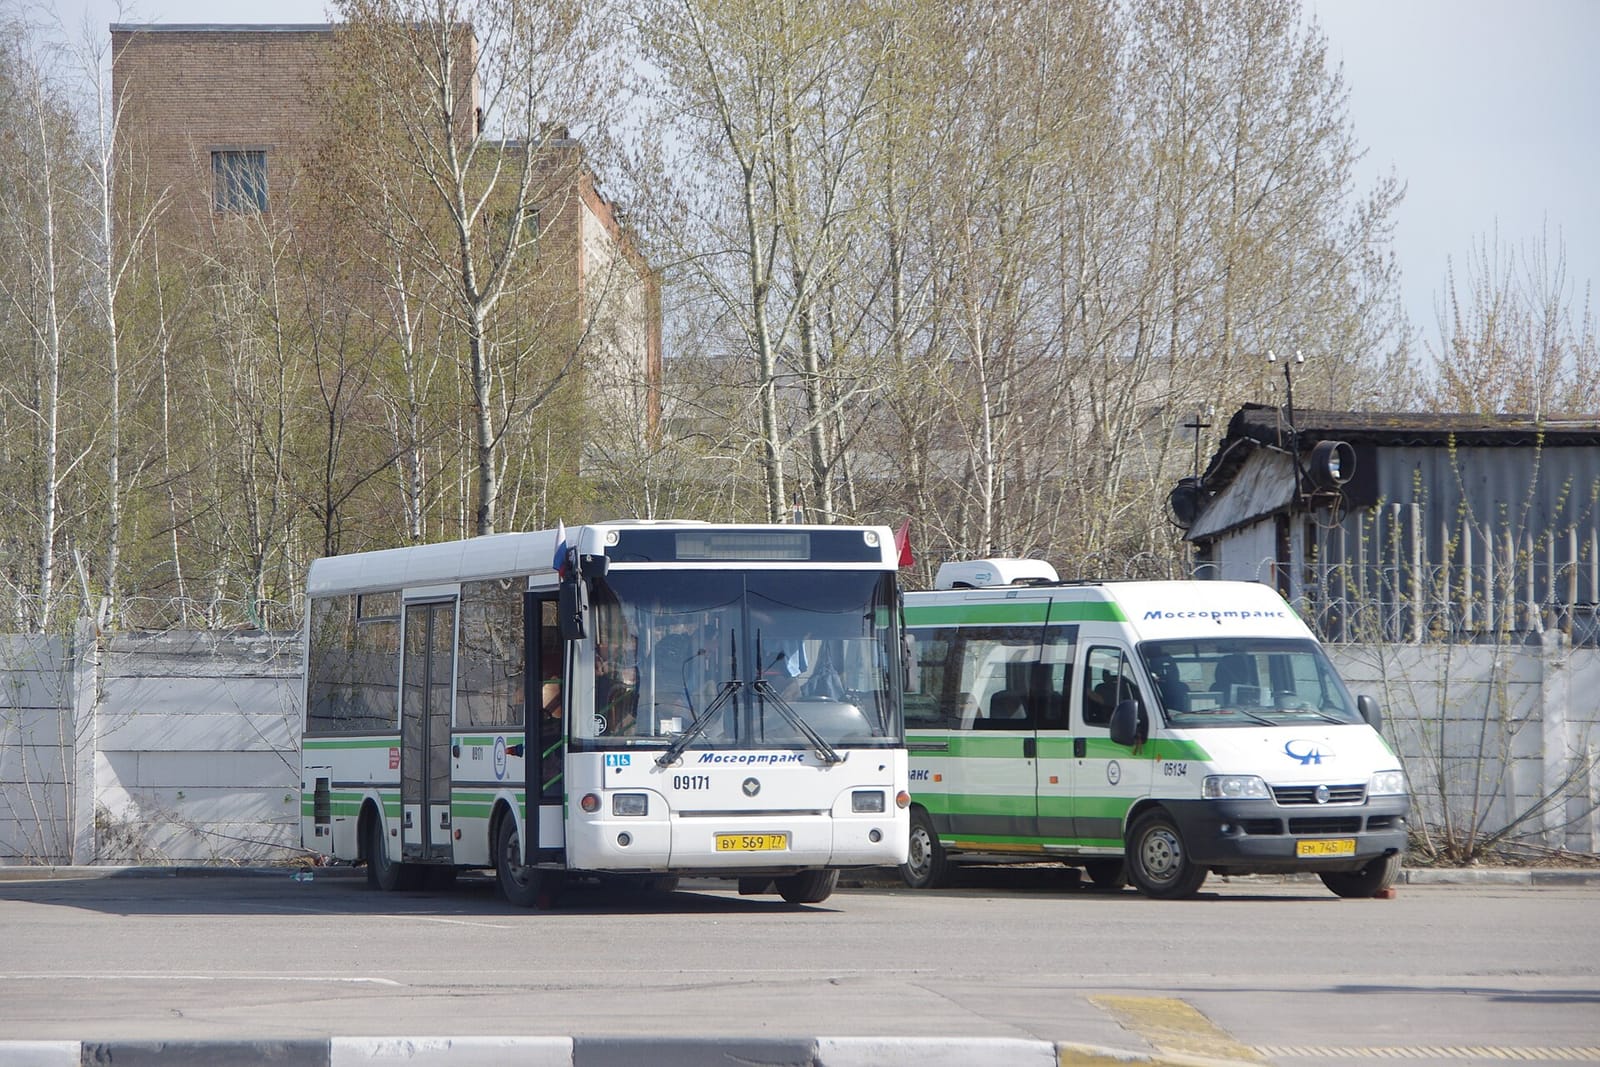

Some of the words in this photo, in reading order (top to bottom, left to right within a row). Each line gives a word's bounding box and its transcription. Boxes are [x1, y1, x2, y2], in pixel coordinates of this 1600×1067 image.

[1144, 610, 1285, 620] Мосгортранс
[698, 753, 805, 765] Мосгортранс
[908, 769, 929, 781] анс
[1164, 762, 1187, 776] 05134
[673, 775, 710, 790] 09171
[742, 836, 764, 849] 569
[771, 835, 782, 845] 77
